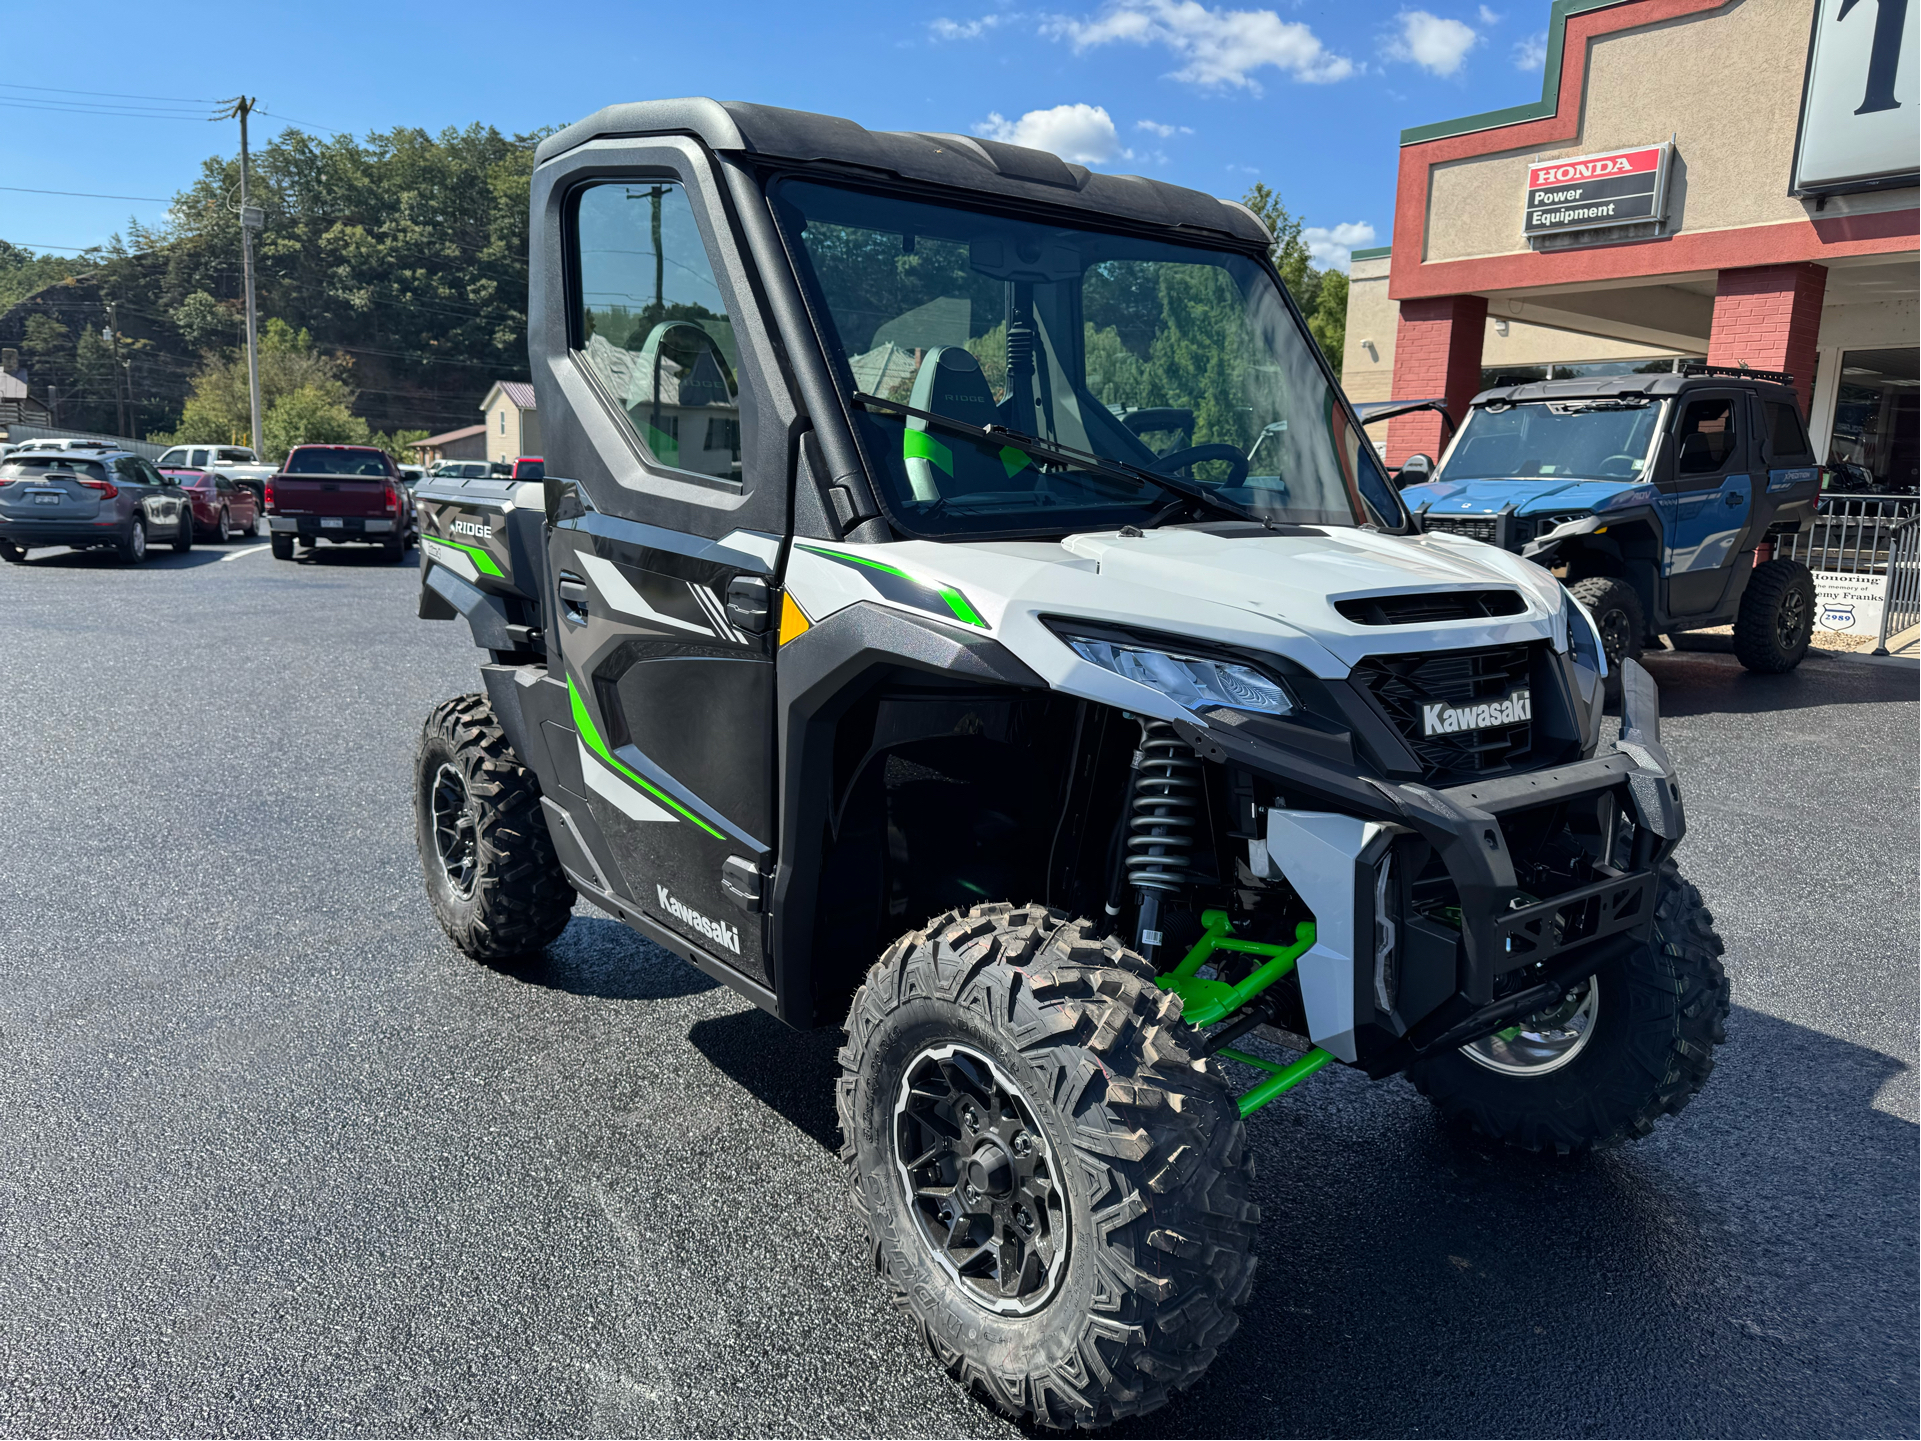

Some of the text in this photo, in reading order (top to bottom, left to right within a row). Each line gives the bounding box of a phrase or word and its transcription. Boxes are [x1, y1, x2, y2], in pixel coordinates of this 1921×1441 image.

[1536, 157, 1632, 184] HONDA
[1534, 188, 1583, 205] Power
[1532, 203, 1615, 226] Equipment
[944, 394, 985, 403] RIDGE
[1631, 490, 1651, 501] ADV
[454, 519, 492, 539] RIDGE
[1817, 592, 1883, 601] emy Franks
[1423, 690, 1532, 736] Kawasaki
[656, 883, 741, 955] Kawasaki
